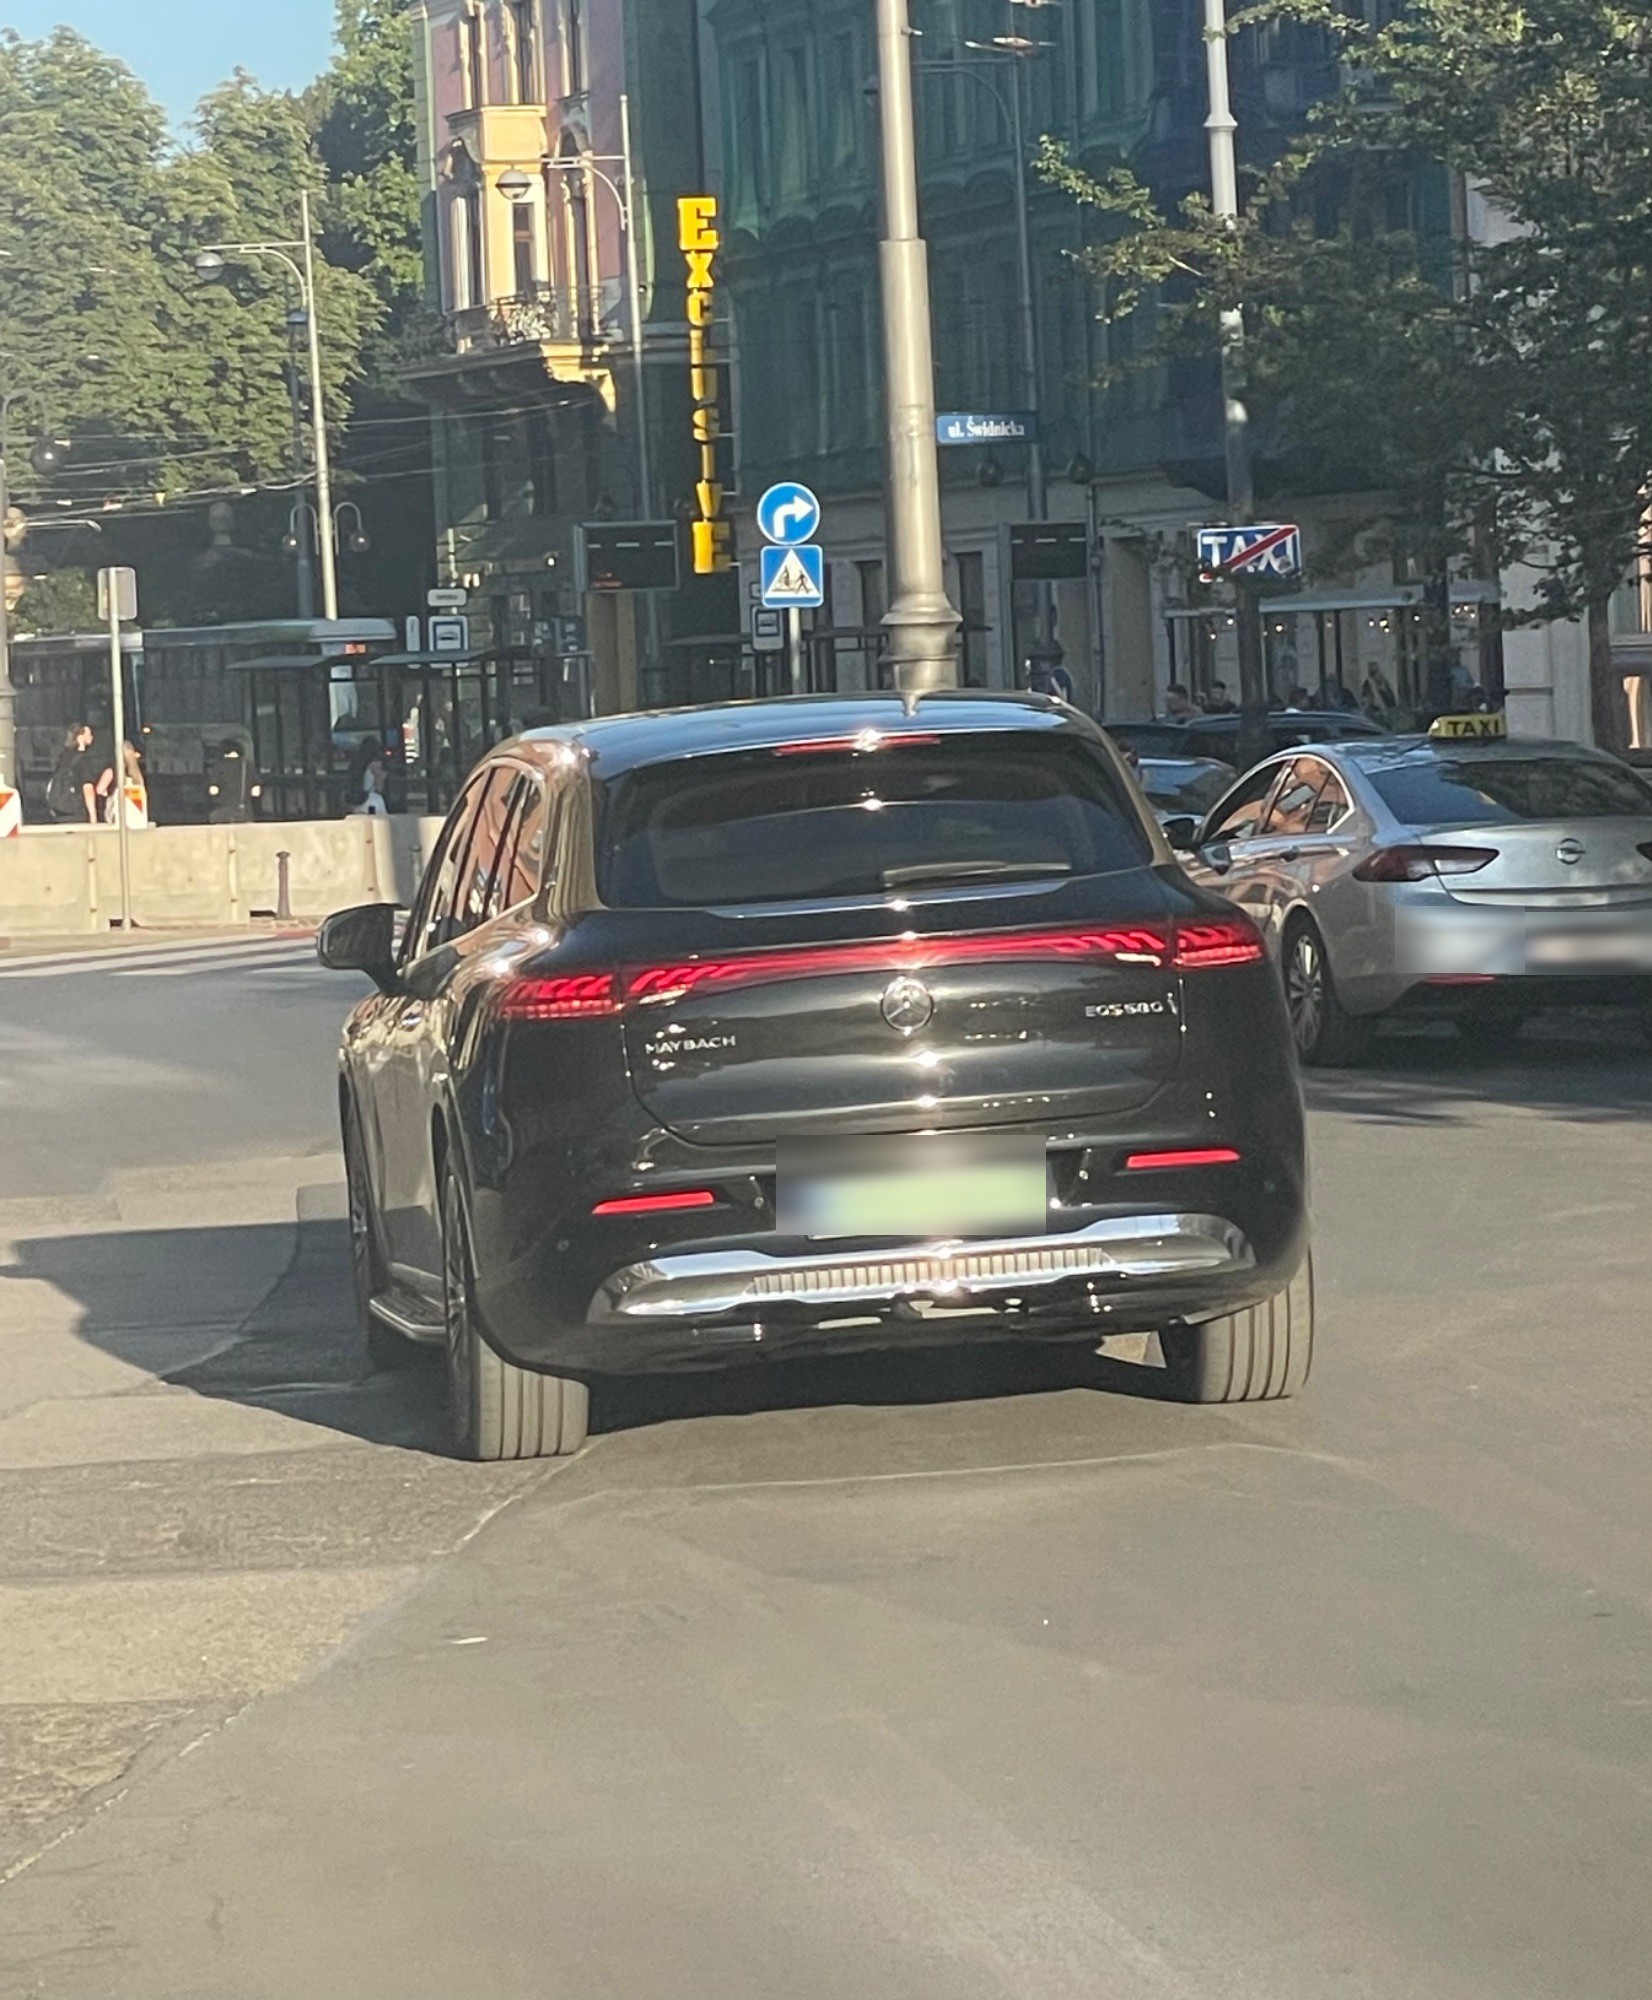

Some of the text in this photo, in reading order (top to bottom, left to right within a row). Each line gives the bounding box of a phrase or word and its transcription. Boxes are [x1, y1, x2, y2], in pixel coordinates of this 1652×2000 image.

[947, 415, 1025, 438] ul. Świdnicka
[1202, 533, 1296, 574] TAXI
[1447, 719, 1500, 736] TAXI
[645, 1035, 736, 1054] MAYBACH
